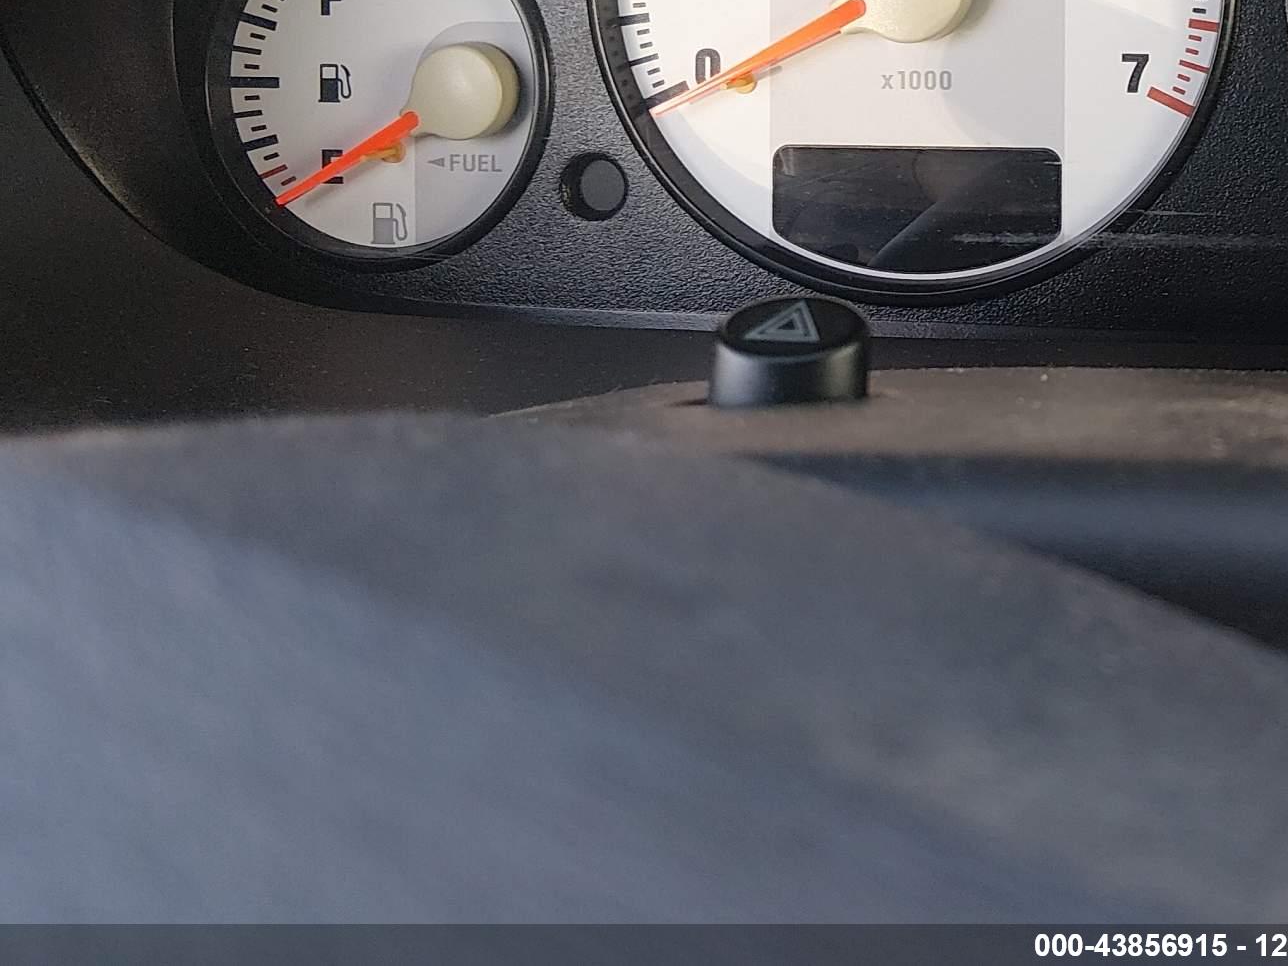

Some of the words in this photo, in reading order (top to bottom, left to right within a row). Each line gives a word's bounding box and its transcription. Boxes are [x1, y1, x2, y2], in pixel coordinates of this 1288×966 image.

[694, 47, 722, 83] 0
[1120, 53, 1150, 93] 7
[880, 70, 953, 91] x1000
[449, 154, 503, 173] FUEL
